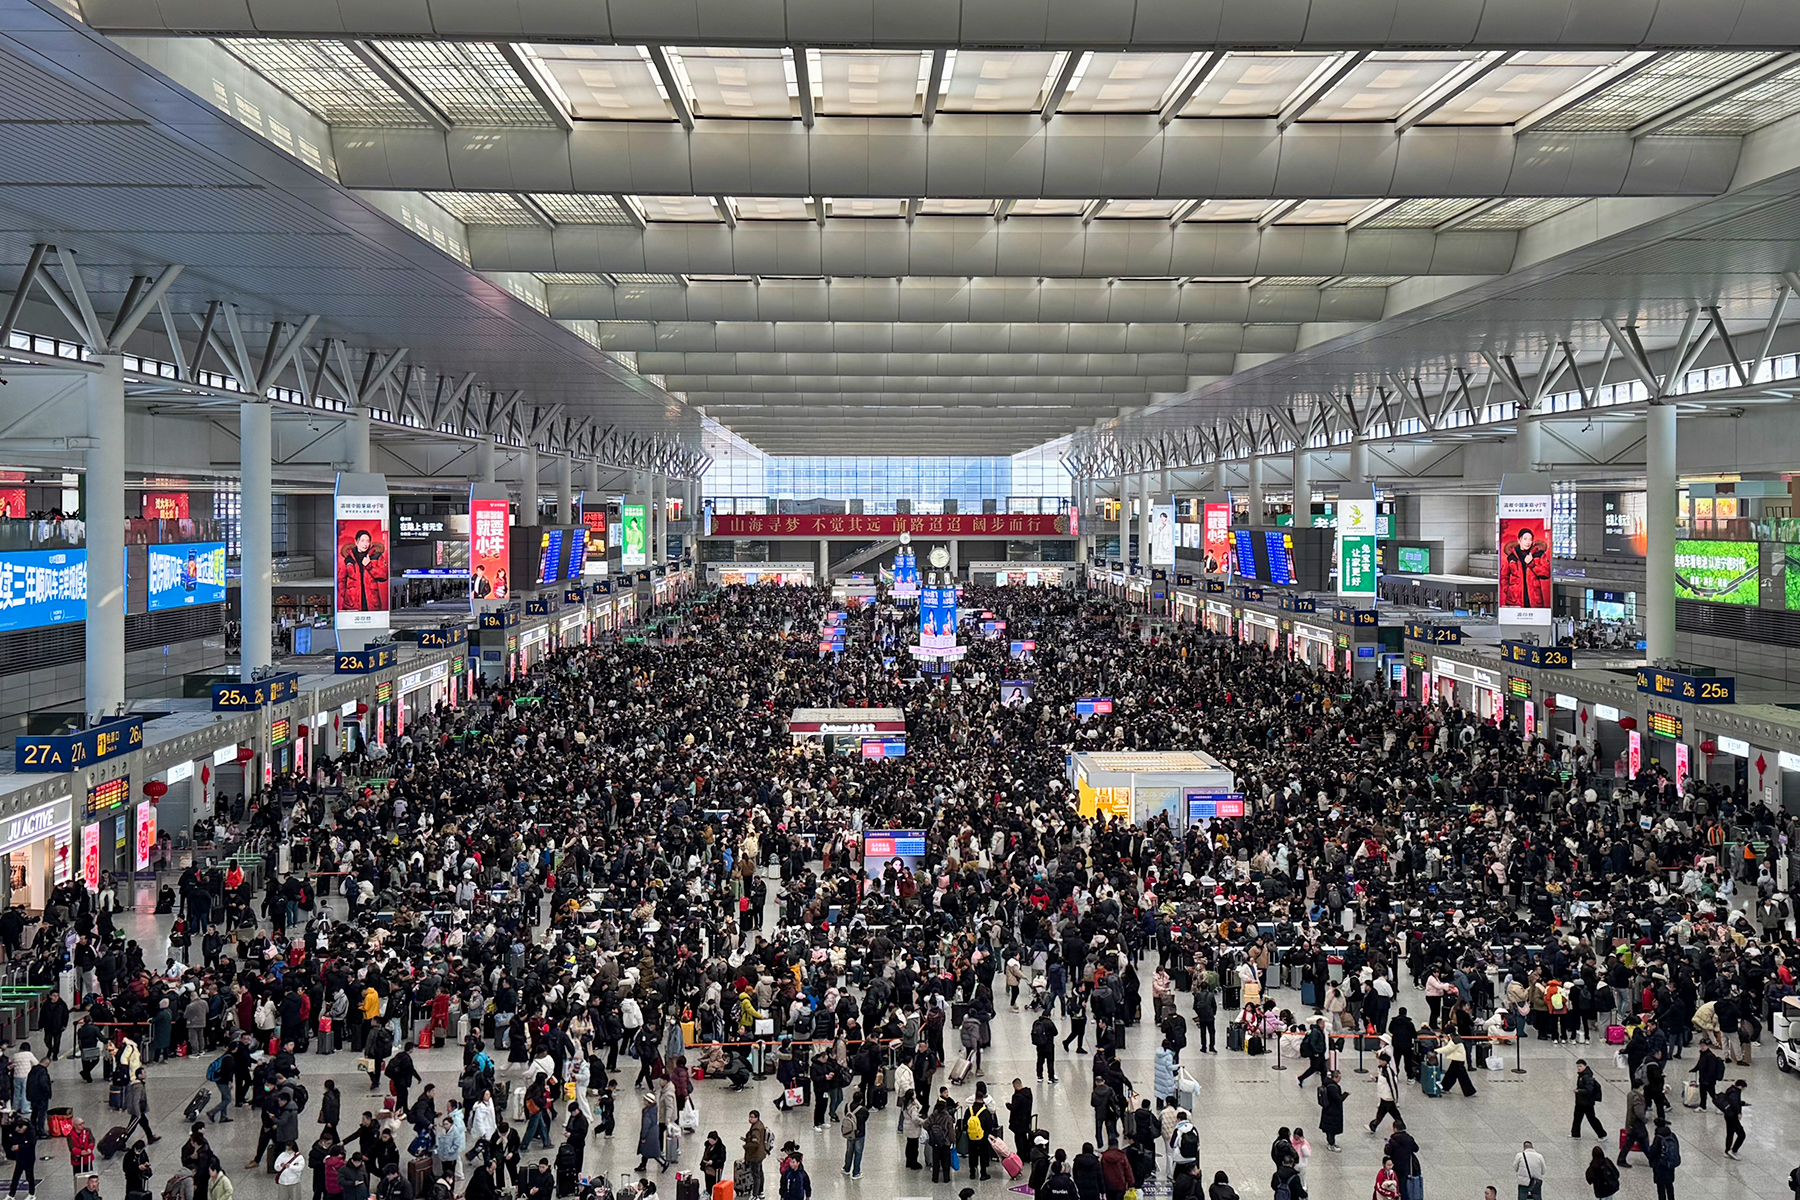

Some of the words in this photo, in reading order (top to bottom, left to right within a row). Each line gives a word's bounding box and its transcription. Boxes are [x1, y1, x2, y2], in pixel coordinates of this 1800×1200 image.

[400, 522, 421, 532] 在路上
[476, 520, 504, 537] 就要
[730, 516, 800, 532] 山海寻梦
[812, 516, 881, 532] 不觉其远
[892, 516, 962, 532] 前路迢迢
[973, 516, 1041, 532] 阔步而行
[1207, 529, 1228, 542] 小牛
[476, 536, 505, 554] 小牛
[529, 604, 544, 612] 17A
[484, 616, 500, 626] 19A
[422, 634, 442, 645] 21A
[1438, 630, 1458, 641] 21B
[340, 656, 364, 669] 23A
[1545, 652, 1568, 664] 23B
[219, 690, 248, 705] 25A
[1682, 682, 1695, 698] 25B
[1702, 683, 1728, 698] 25B
[129, 726, 142, 744] 26A
[24, 744, 62, 764] 27A
[72, 742, 86, 763] 27A
[7, 820, 21, 842] JU
[21, 808, 54, 836] ACTIVE
